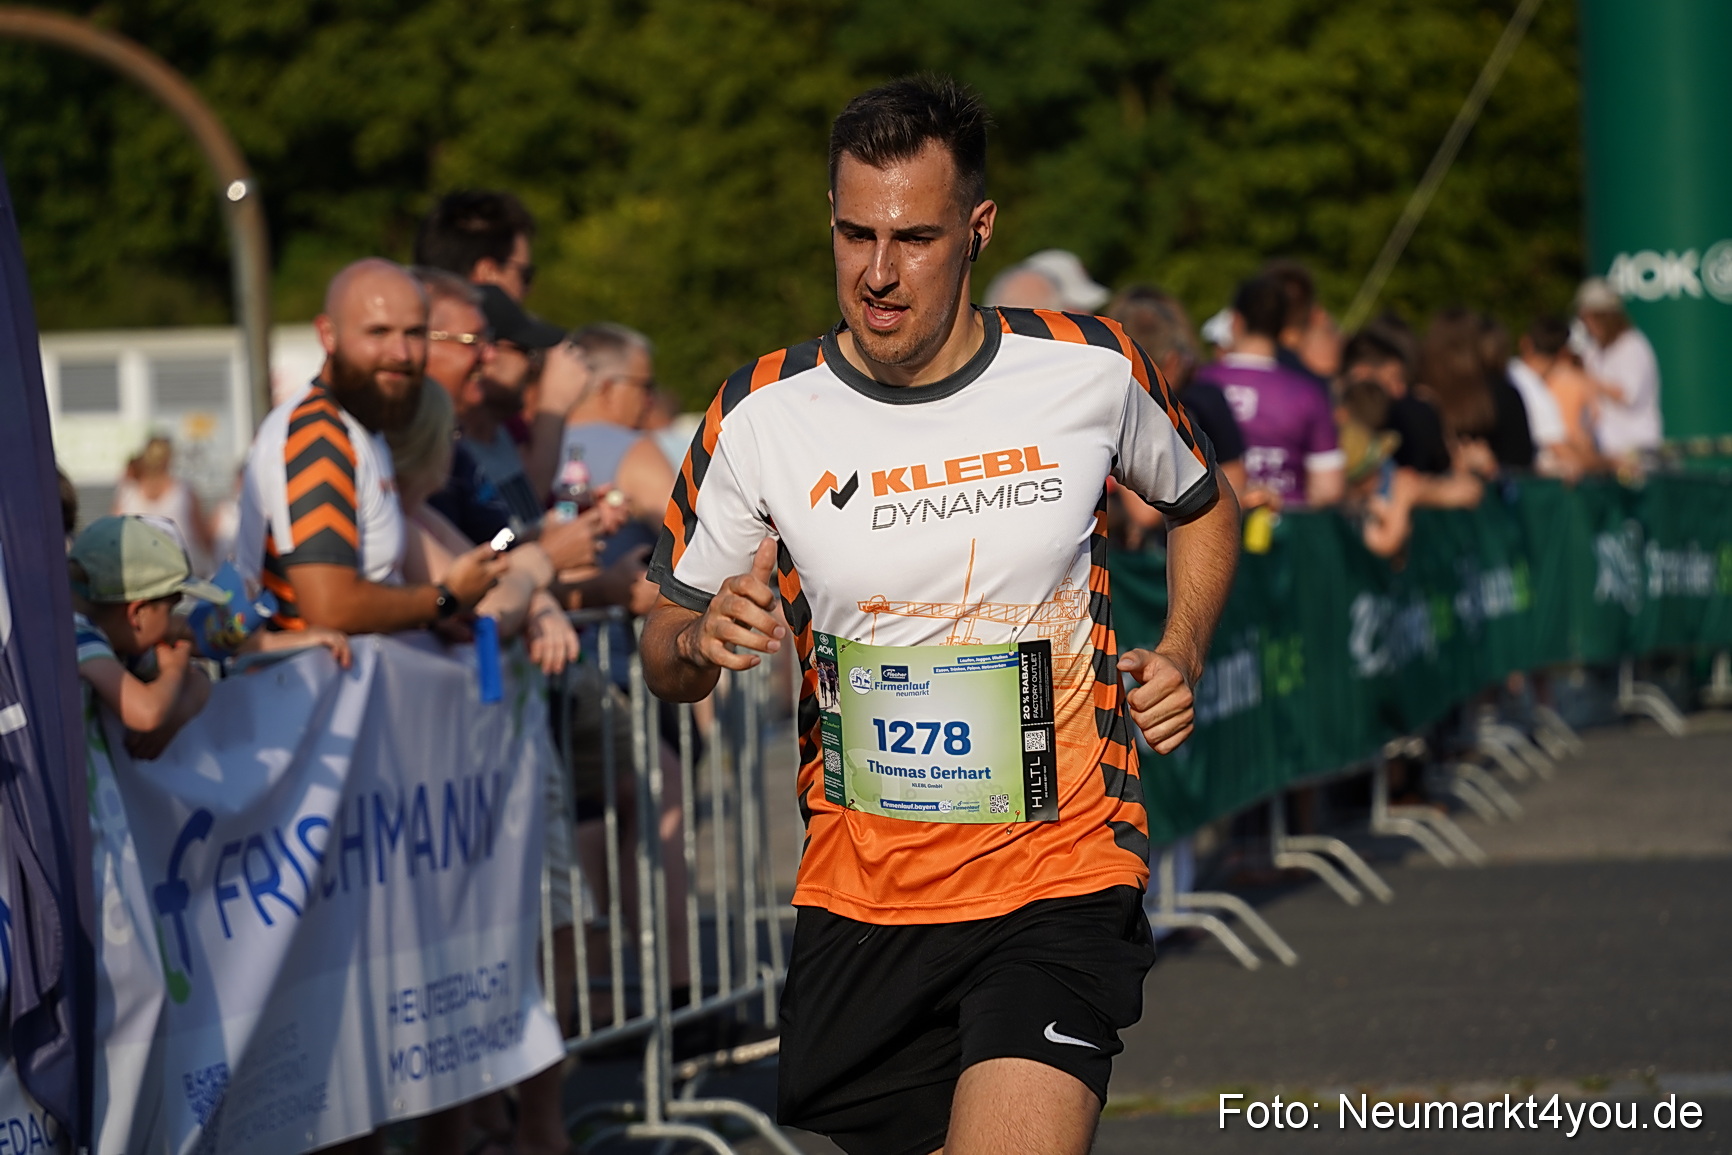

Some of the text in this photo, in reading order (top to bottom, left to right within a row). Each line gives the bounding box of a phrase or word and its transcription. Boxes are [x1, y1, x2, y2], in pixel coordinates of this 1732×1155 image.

[1606, 249, 1702, 302] AOK
[871, 445, 1060, 497] KLEBL
[871, 477, 1063, 531] DYNAMICS
[817, 645, 835, 656] AOK
[874, 680, 930, 691] Firmenlauf
[895, 689, 930, 697] neumarkt
[1021, 652, 1031, 720] 20 % RABATT
[1032, 685, 1040, 719] FACTORY
[872, 717, 972, 756] 1278
[866, 758, 991, 780] Thomas Gerhart
[1030, 756, 1043, 808] HILTL
[882, 801, 937, 812] firmenlauf.bayern
